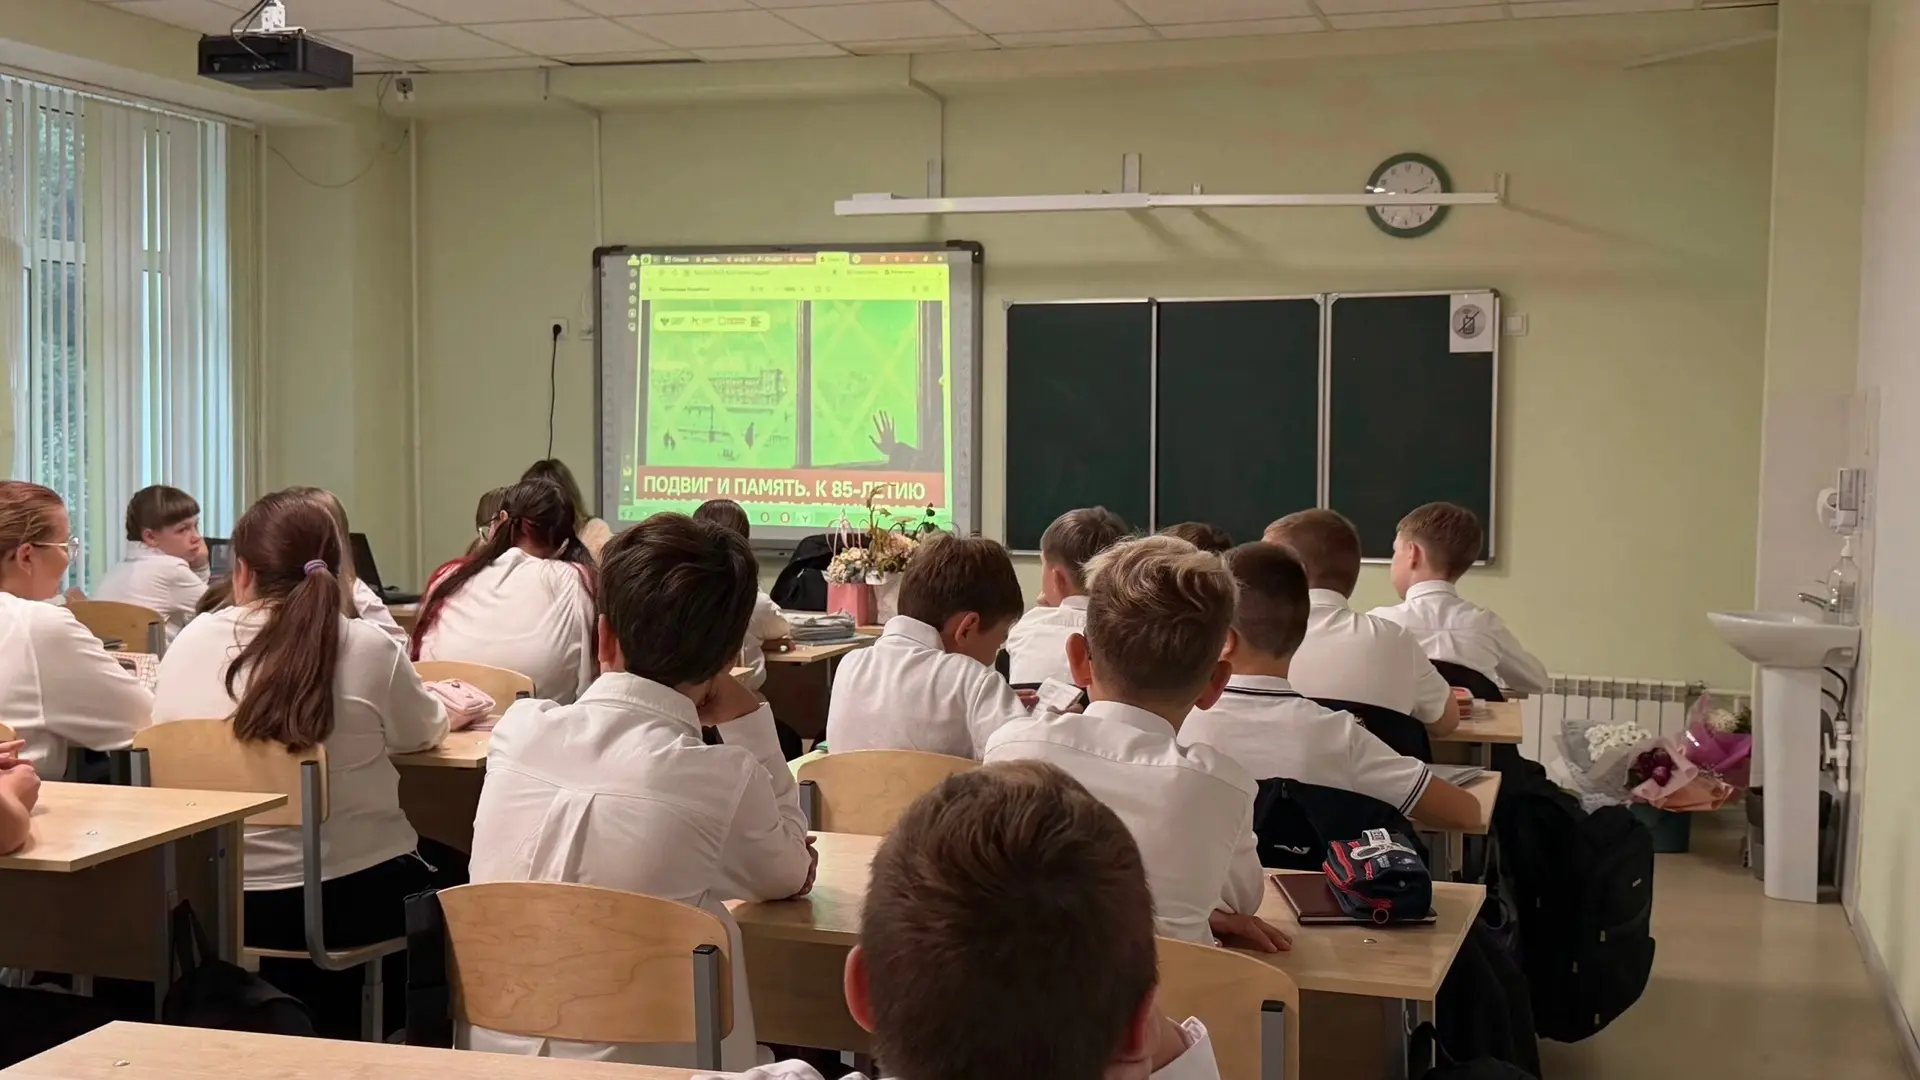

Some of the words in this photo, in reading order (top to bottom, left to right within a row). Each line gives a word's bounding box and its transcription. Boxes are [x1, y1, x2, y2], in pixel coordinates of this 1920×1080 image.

[643, 475, 714, 497] ПОДВИГ
[717, 477, 730, 495] И
[734, 477, 811, 498] ПАМЯТЬ.
[815, 479, 828, 498] К
[831, 480, 926, 500] 85-ЛЕТИЮ
